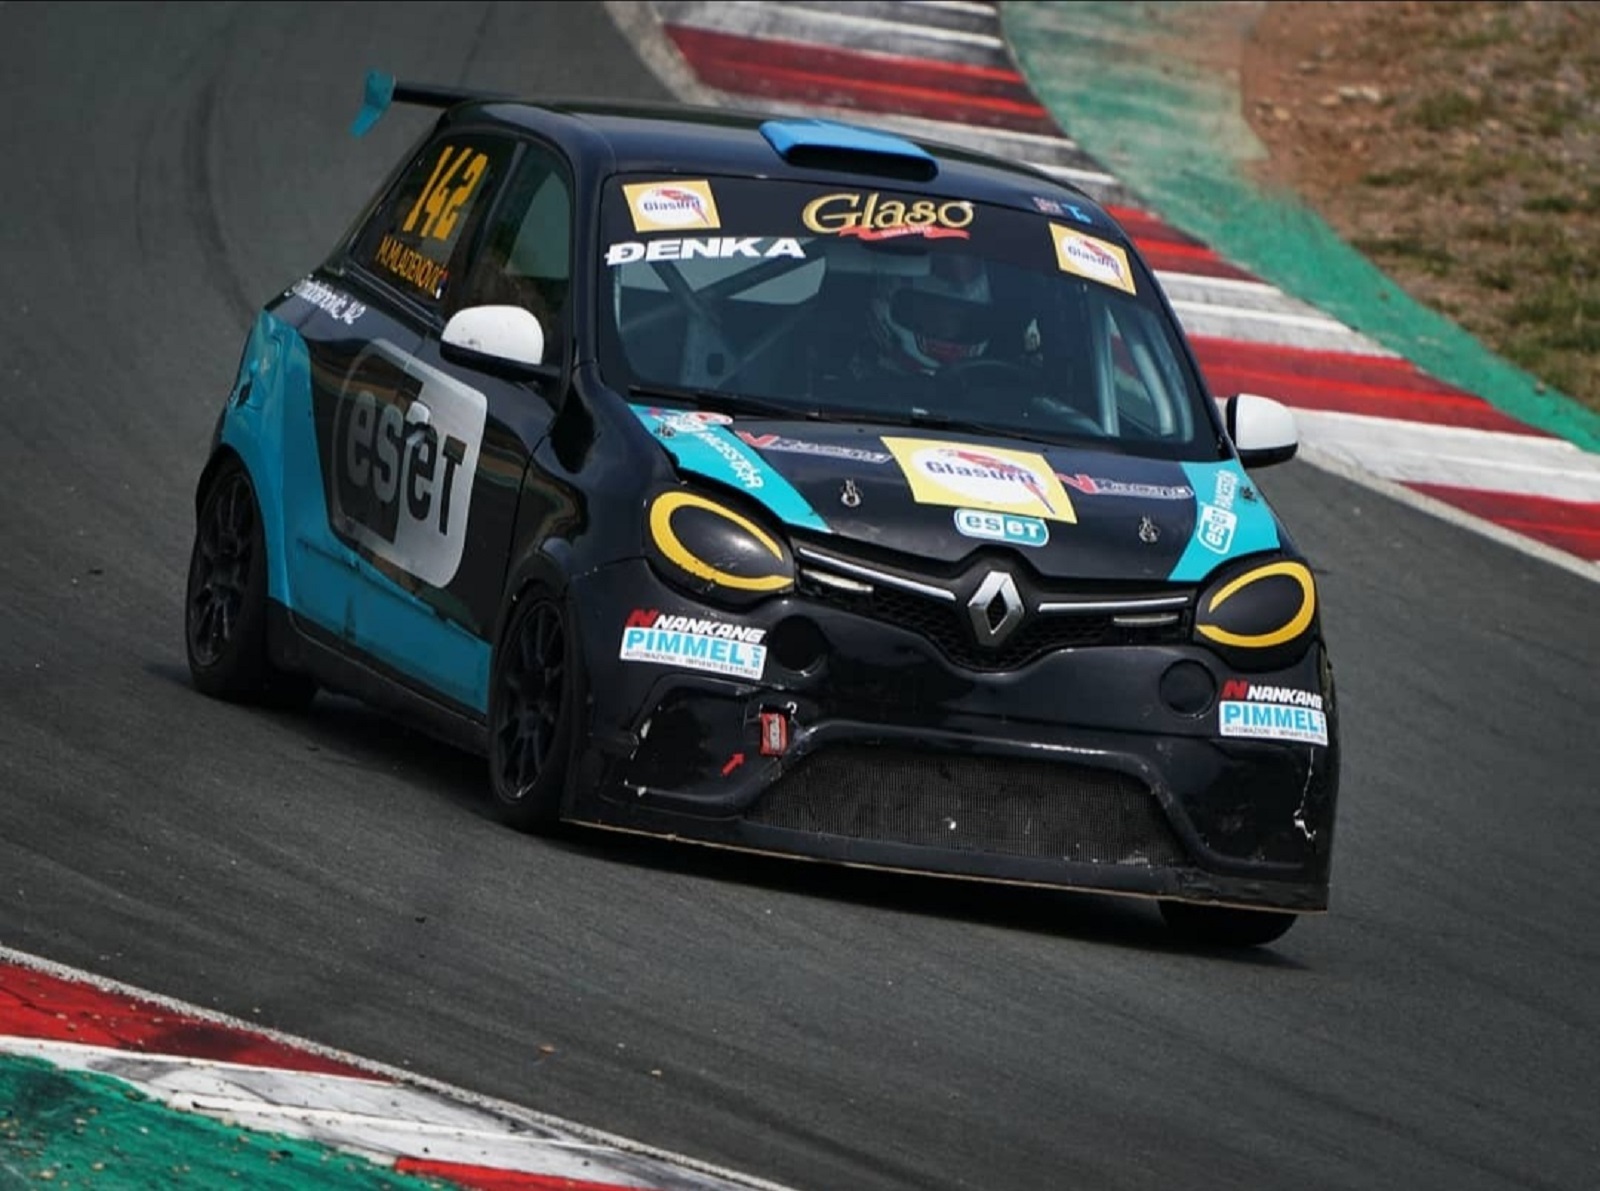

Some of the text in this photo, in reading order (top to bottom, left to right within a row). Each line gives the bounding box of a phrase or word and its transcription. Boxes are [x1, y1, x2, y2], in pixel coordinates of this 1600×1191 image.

[403, 146, 488, 240] 142
[802, 193, 975, 233] Glaso
[653, 614, 767, 644] NANKANG
[626, 629, 745, 666] PIMMEL
[1246, 684, 1323, 711] NANKANG
[1223, 703, 1319, 732] PIMMEL
